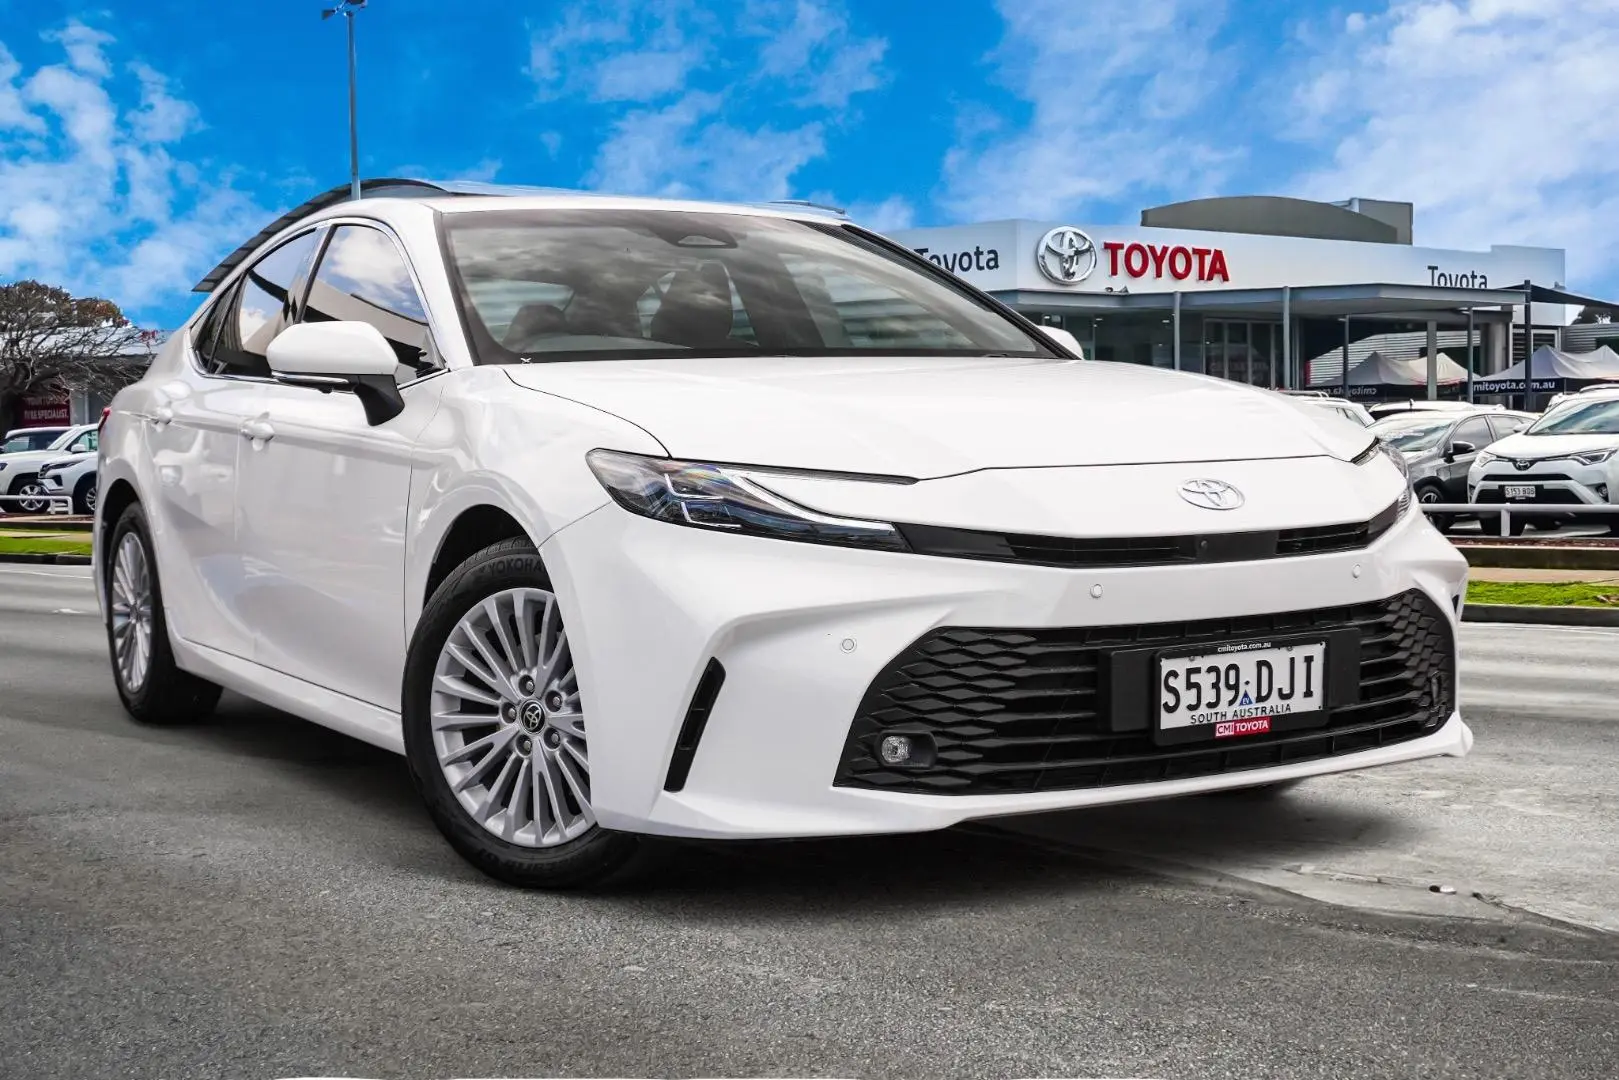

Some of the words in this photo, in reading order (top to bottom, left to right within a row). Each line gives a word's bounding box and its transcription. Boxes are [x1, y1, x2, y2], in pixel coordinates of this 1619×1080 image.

[1103, 242, 1230, 282] TOYOTA
[1427, 265, 1488, 289] Toyota
[1473, 381, 1556, 393] mitoyota.cm.au
[1217, 641, 1272, 653] cmitoyota.com.au
[1190, 711, 1228, 725] SOUTH
[1232, 703, 1292, 719] AUSTRALIA
[1235, 720, 1269, 732] TOYOTA
